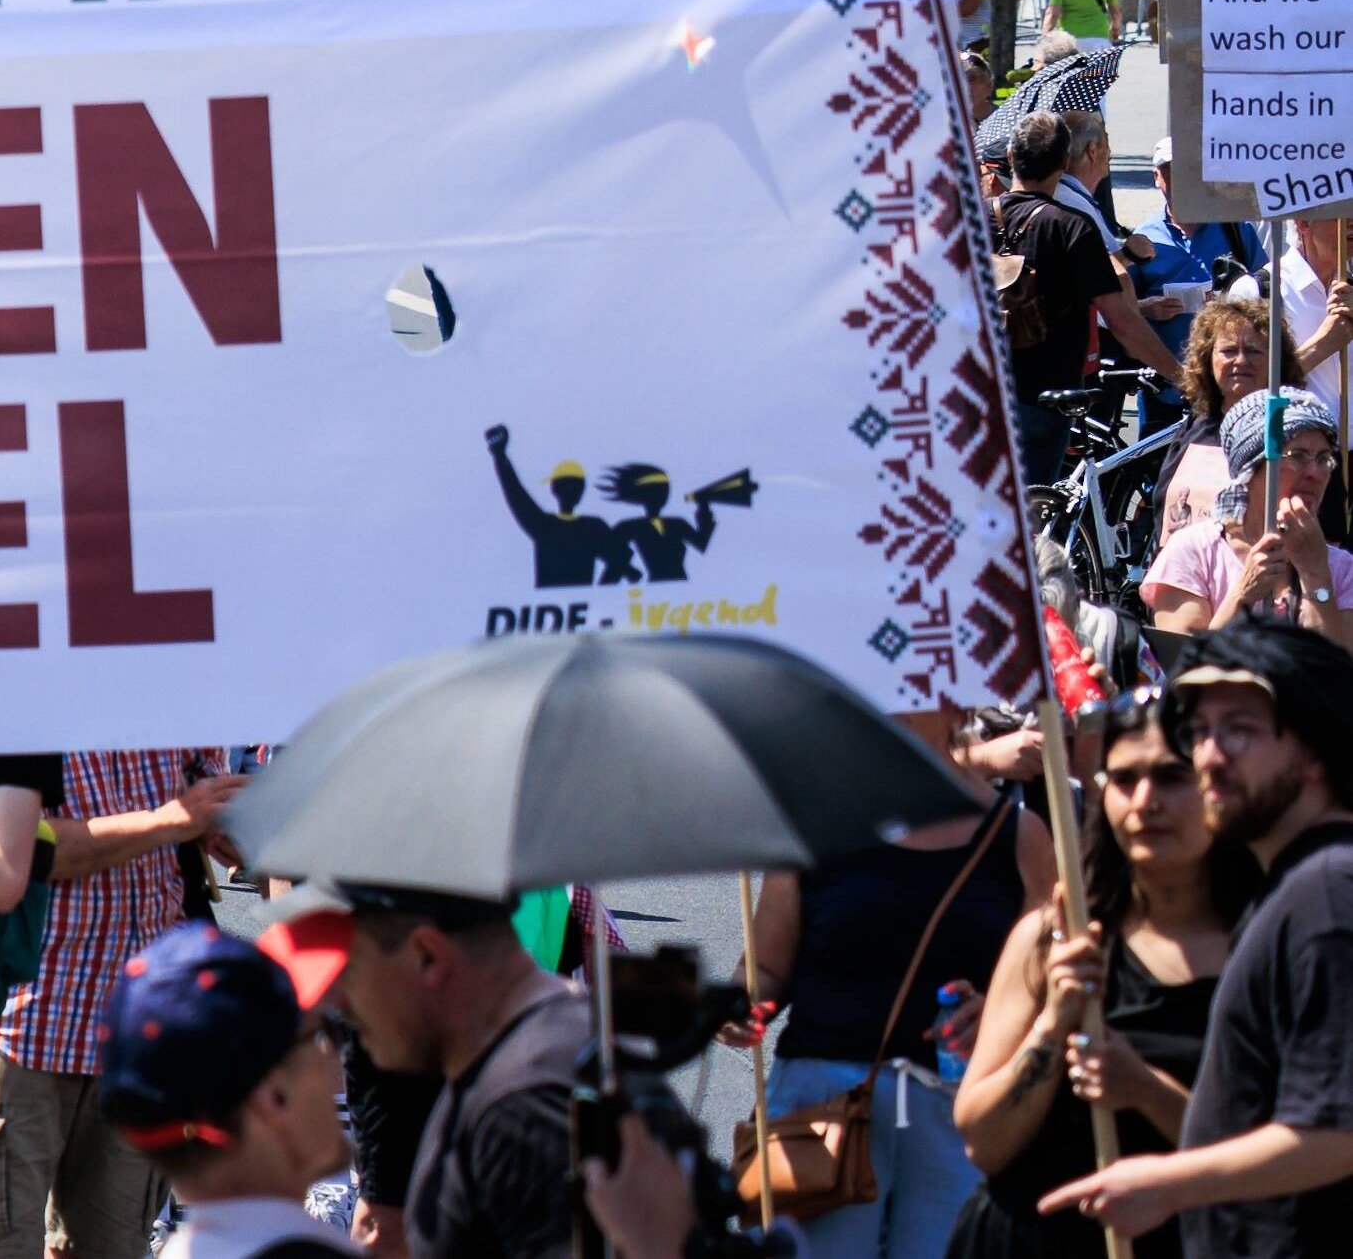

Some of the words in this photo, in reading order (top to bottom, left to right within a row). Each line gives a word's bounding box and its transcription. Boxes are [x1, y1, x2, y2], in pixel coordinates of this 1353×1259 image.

[1210, 24, 1285, 50] wash
[1295, 29, 1346, 49] our
[1211, 89, 1298, 116] hands
[1309, 92, 1334, 116] in
[1210, 137, 1345, 160] innocence
[485, 602, 589, 637] DIDF
